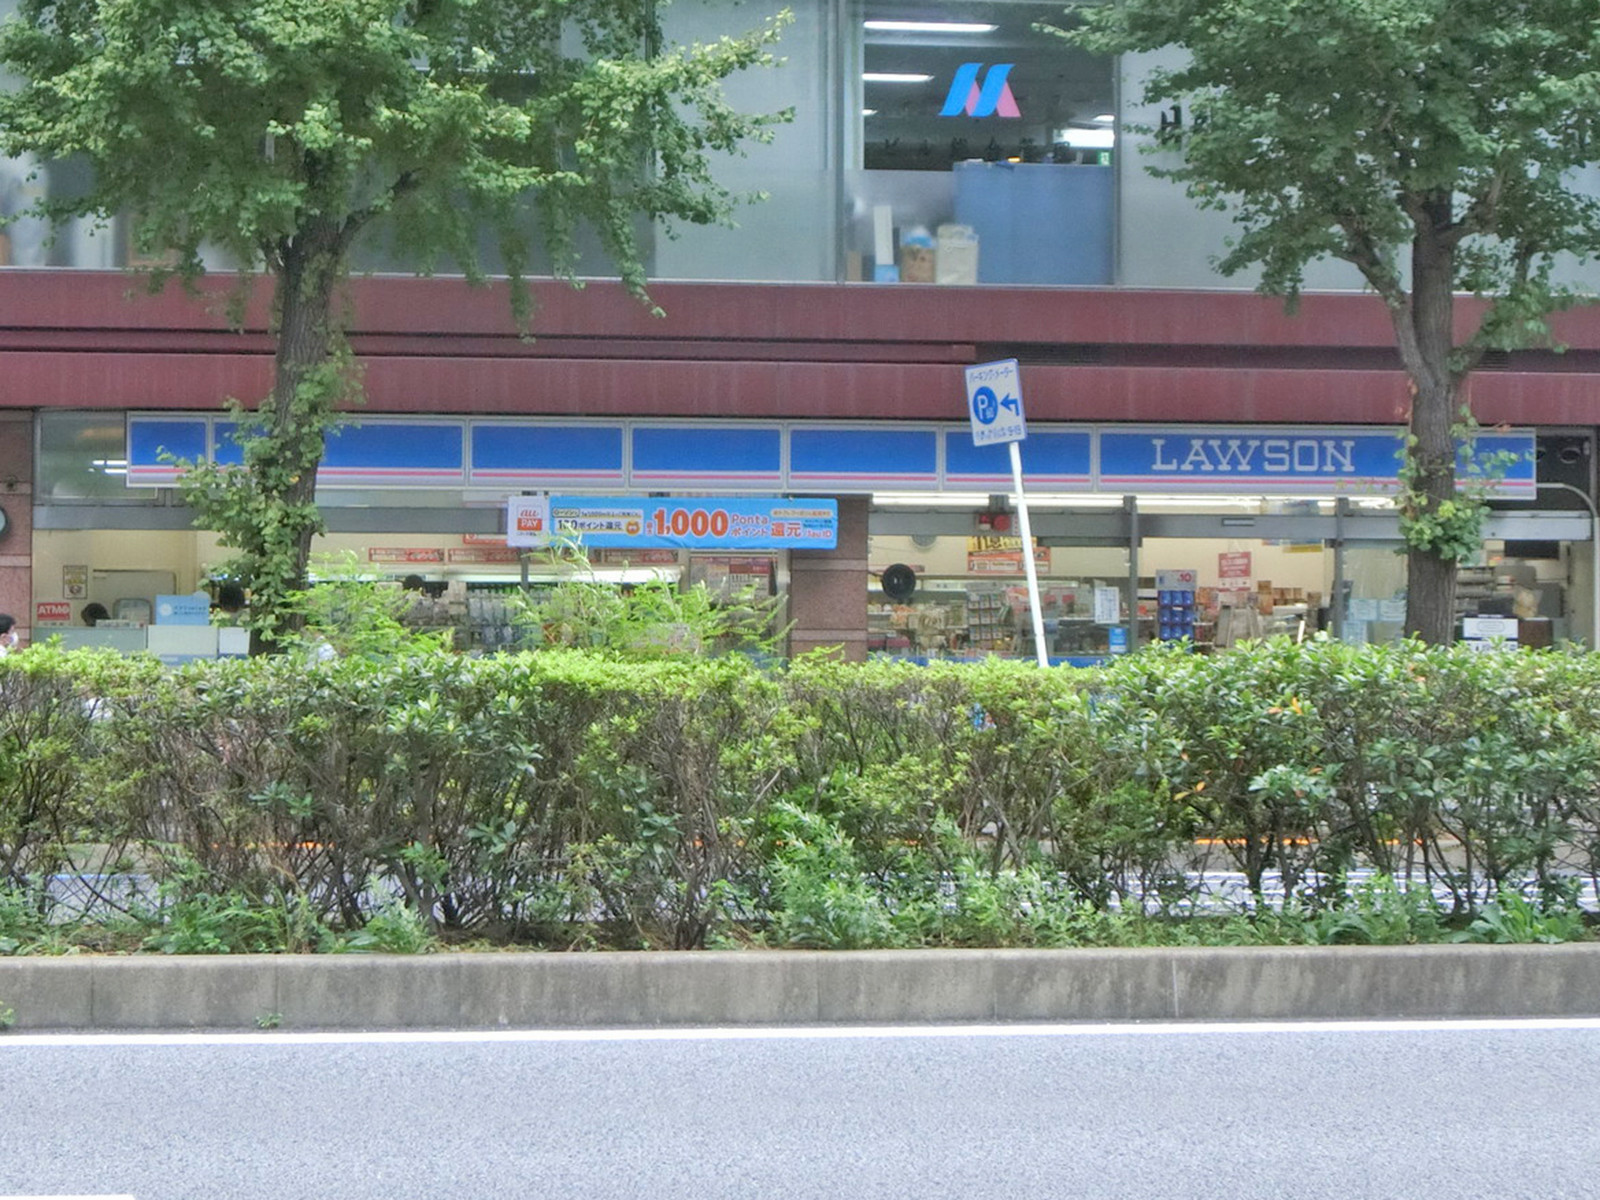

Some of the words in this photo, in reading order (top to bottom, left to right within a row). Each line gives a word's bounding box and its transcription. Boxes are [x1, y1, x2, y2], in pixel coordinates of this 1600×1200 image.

[1152, 438, 1356, 472] LAWSON
[521, 518, 538, 528] PAY
[653, 509, 729, 537] 1,000
[731, 514, 768, 525] Ponta
[731, 527, 767, 537] ポイント
[771, 522, 801, 537] 還元
